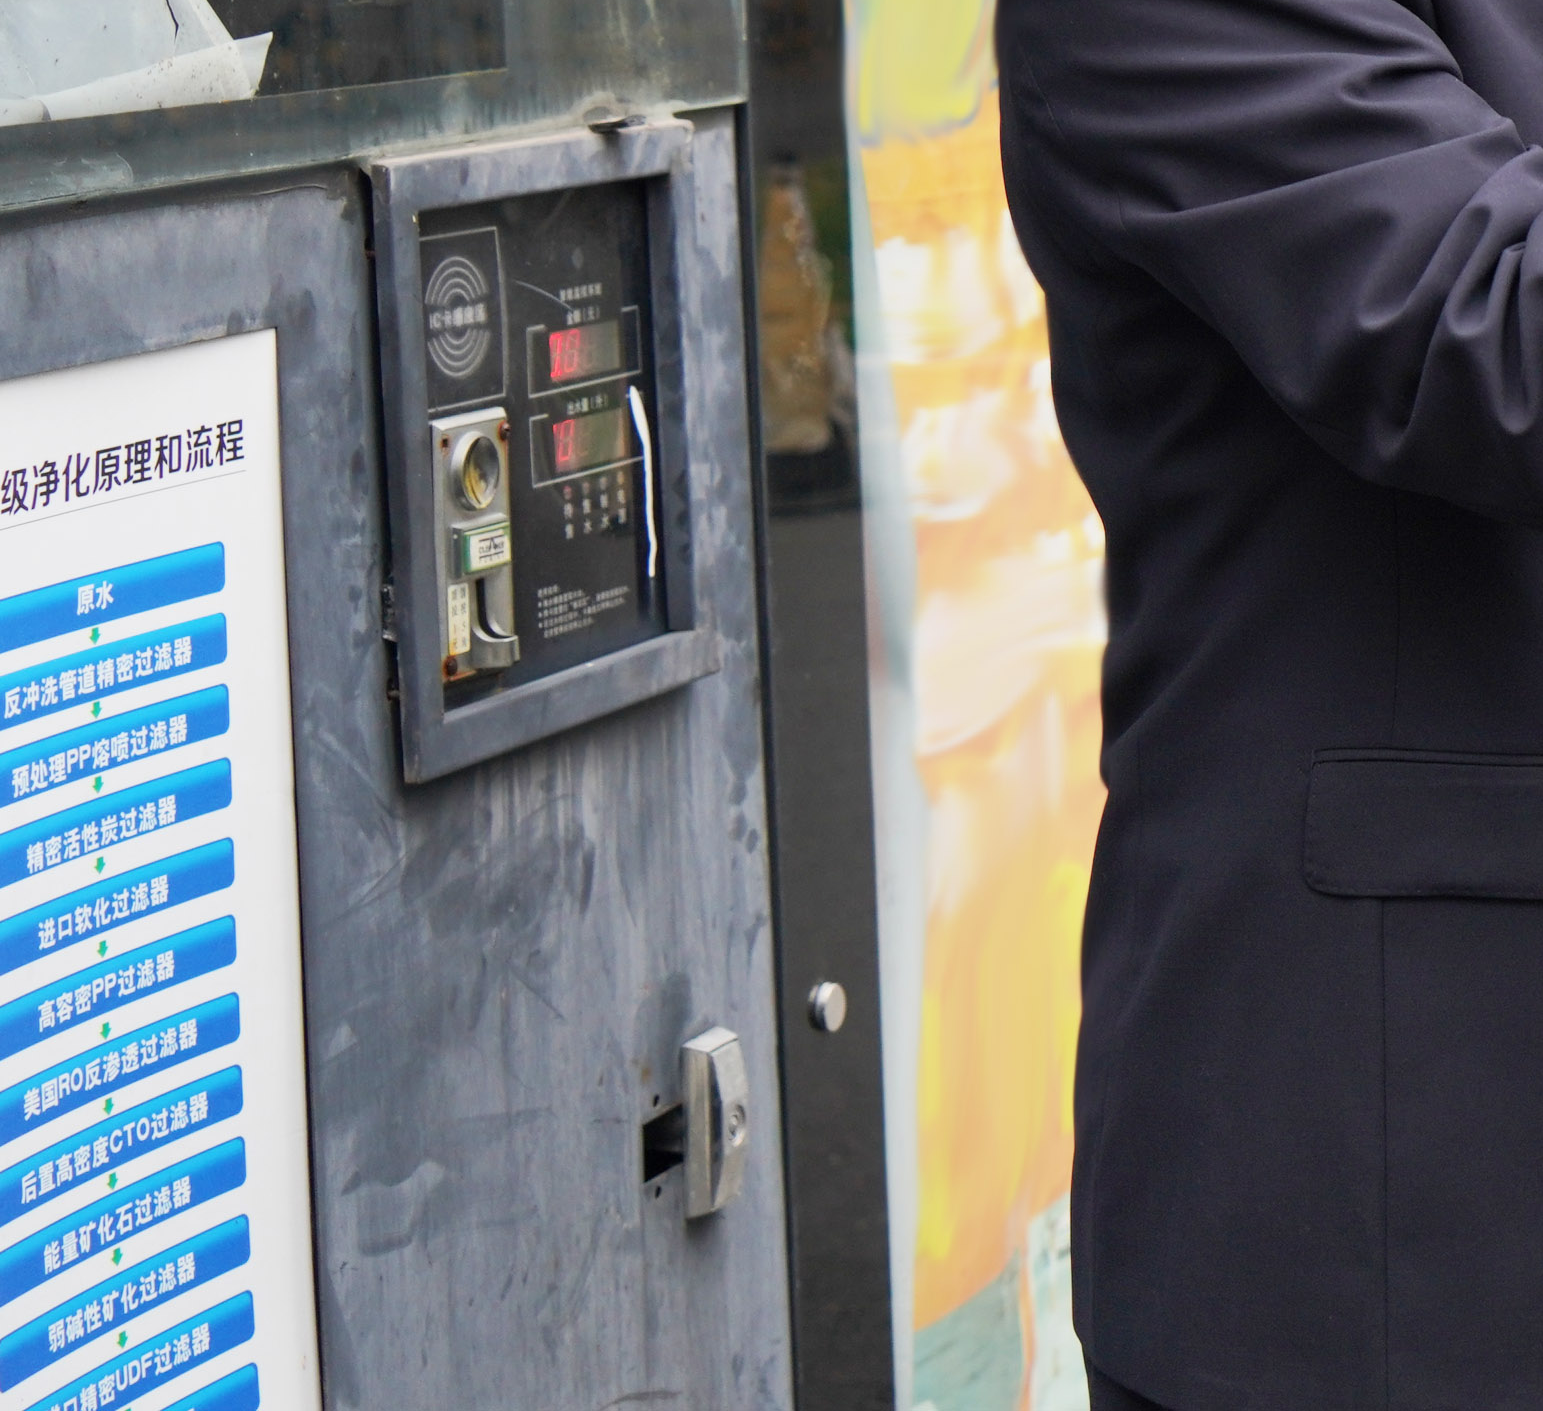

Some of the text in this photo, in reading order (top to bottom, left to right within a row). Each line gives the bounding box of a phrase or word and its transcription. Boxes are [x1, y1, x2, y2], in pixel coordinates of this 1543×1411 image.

[0, 418, 245, 516] 级净化原理和流程
[76, 580, 114, 616] 原水
[4, 635, 193, 719] 反冲洗管道精密过滤器
[12, 714, 188, 798] 预处理PP熔喷过滤器
[26, 794, 177, 875] 精密活性炭过滤器
[38, 874, 169, 951] 进口软化过滤器
[38, 950, 175, 1032] 高容密PP过滤器
[23, 1018, 198, 1121] 美国RO反渗透过滤器
[21, 1091, 208, 1204] 后置高密度CTO过滤器
[43, 1176, 192, 1275] 能量矿化石过滤器
[48, 1252, 196, 1353] 弱碱性矿化过滤器
